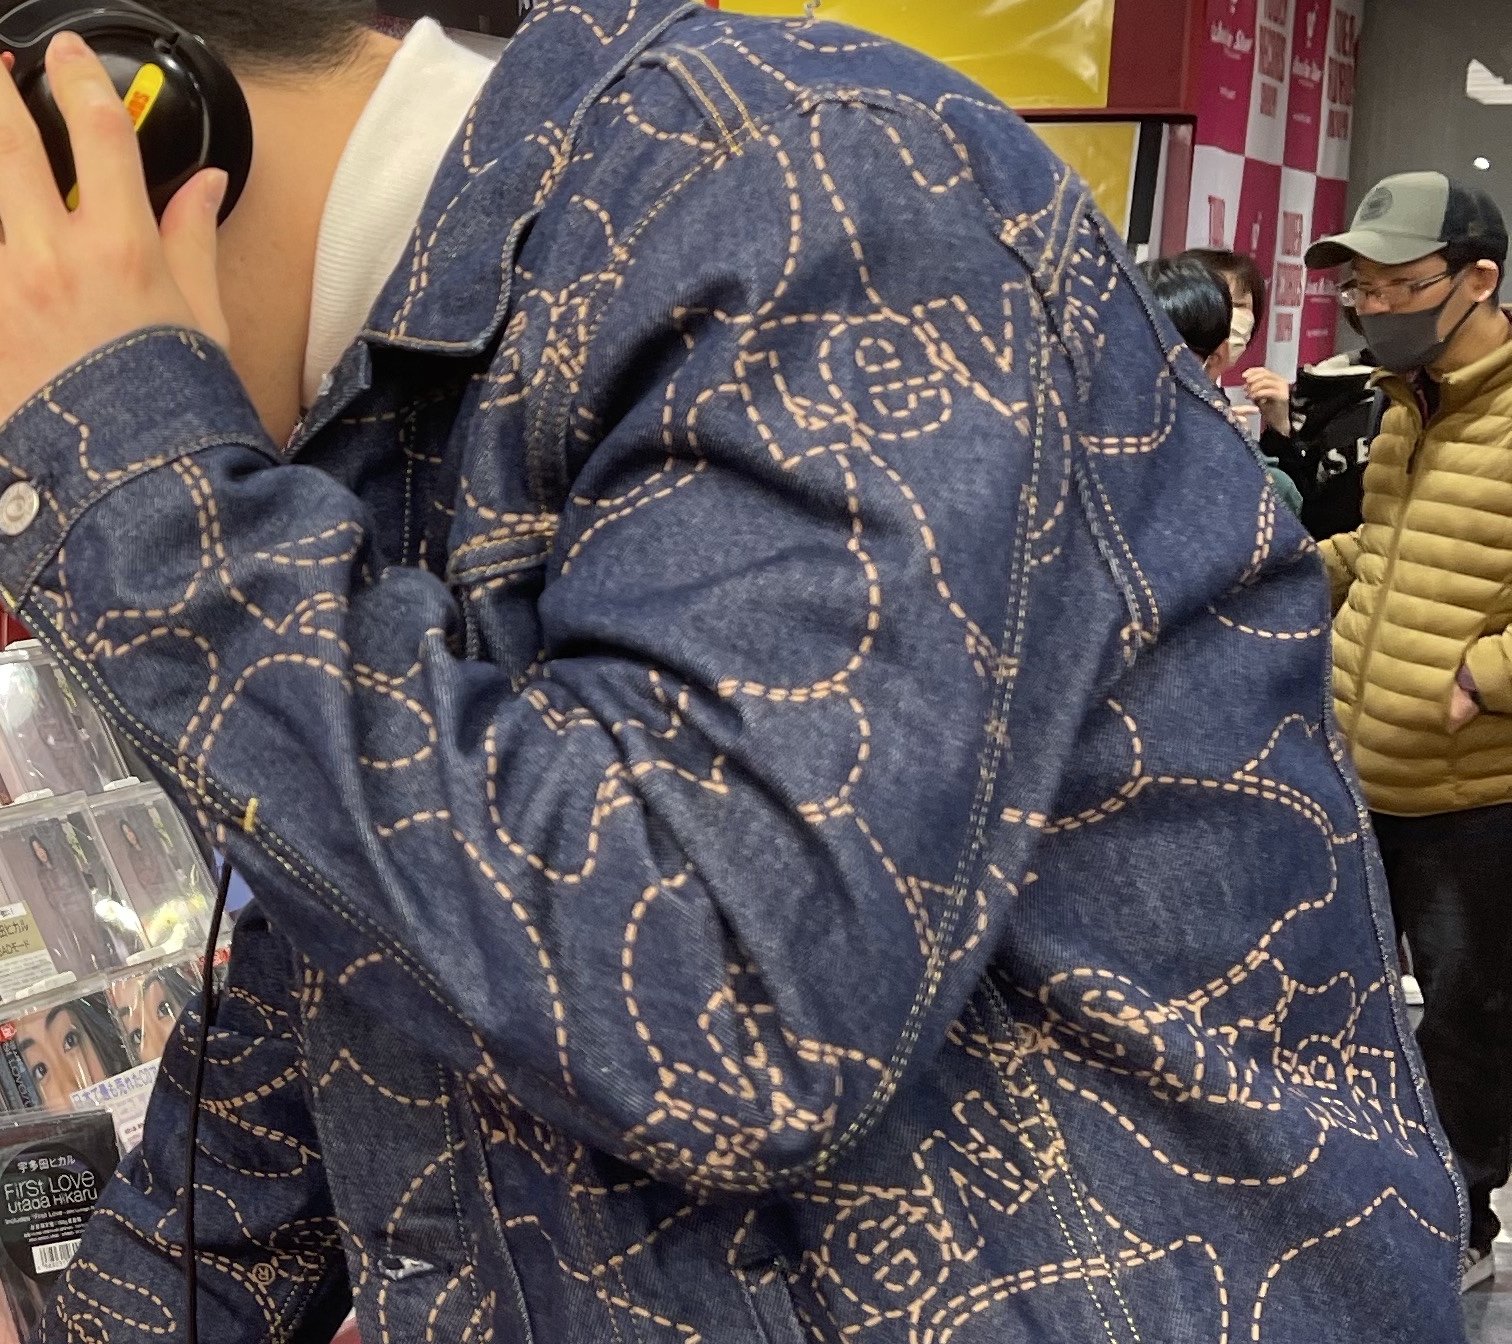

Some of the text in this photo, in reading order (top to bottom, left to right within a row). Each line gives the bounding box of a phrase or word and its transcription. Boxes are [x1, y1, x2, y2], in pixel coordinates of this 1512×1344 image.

[16, 1155, 76, 1174] 宇多田ヒカル
